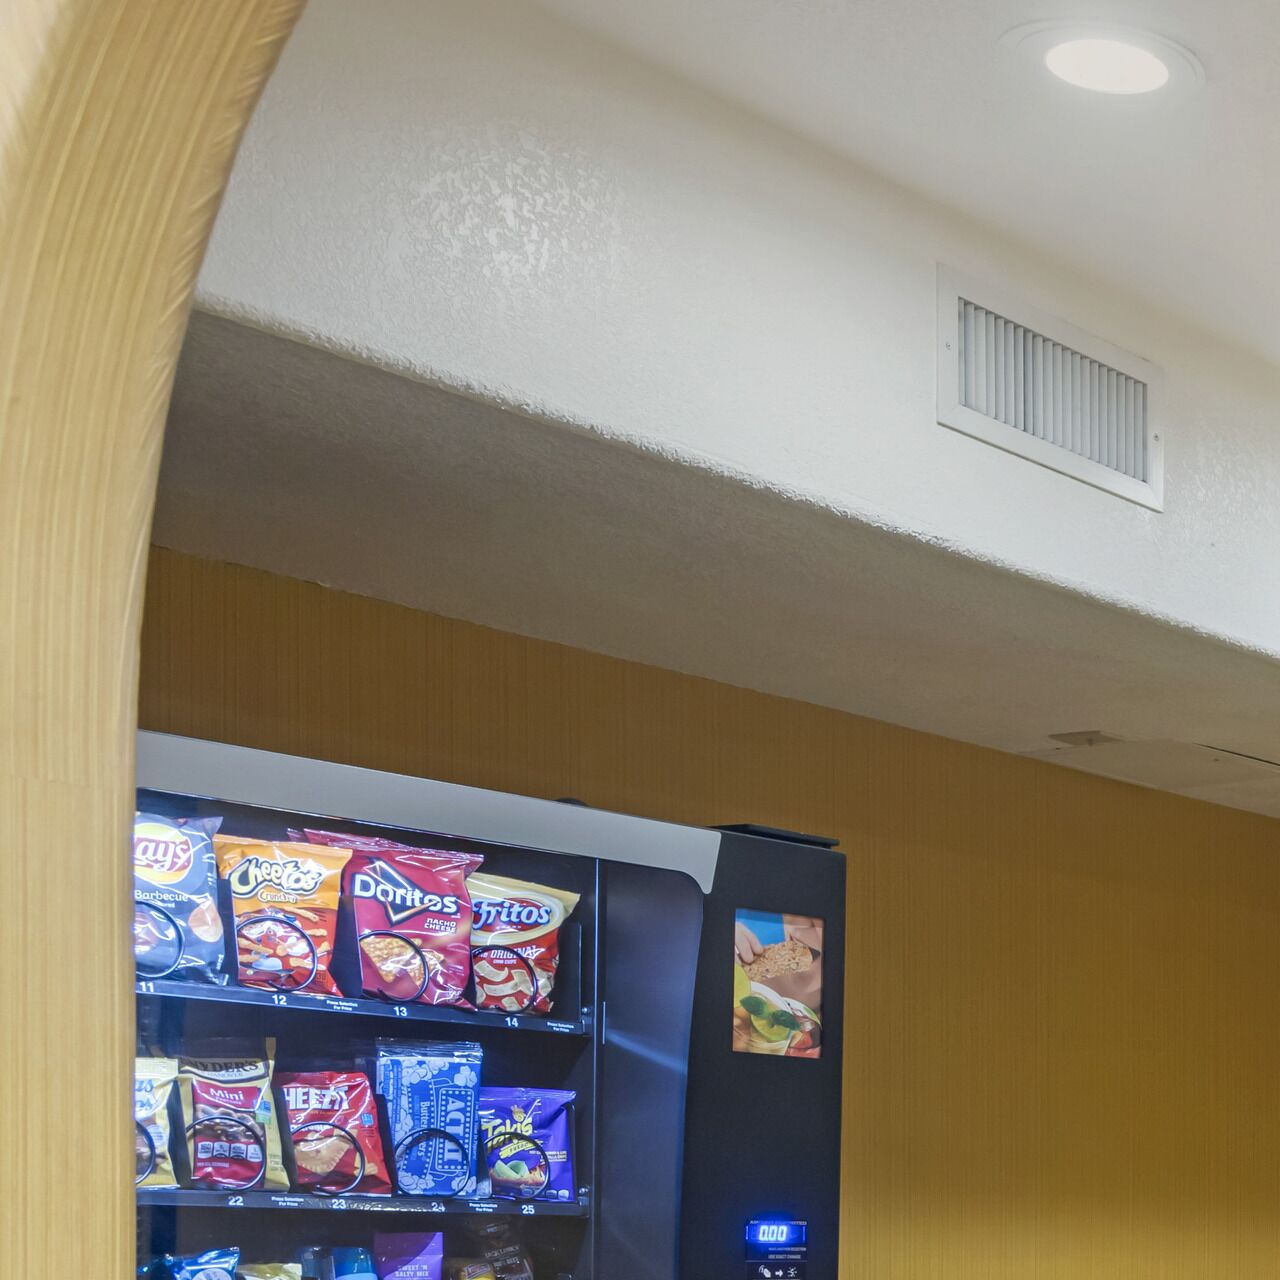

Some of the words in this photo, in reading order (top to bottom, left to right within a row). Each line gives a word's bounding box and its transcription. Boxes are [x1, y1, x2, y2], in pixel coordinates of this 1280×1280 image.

[135, 841, 189, 872] ay's
[230, 857, 322, 893] Cheetos
[135, 889, 188, 902] Barbecue
[353, 873, 458, 914] Doritos
[472, 900, 552, 930] Fritos
[424, 923, 457, 933] CHEESE
[426, 918, 456, 927] NACHO
[139, 981, 154, 993] 11
[272, 995, 287, 1005] 12
[393, 1007, 408, 1017] 13
[505, 1017, 519, 1028] 14
[209, 1088, 244, 1101] Mini
[446, 1096, 465, 1137] ACT
[481, 1117, 533, 1150] Takis
[228, 1196, 244, 1206] 22
[331, 1199, 346, 1209] 23
[431, 1202, 446, 1212] 24
[521, 1204, 535, 1214] 25
